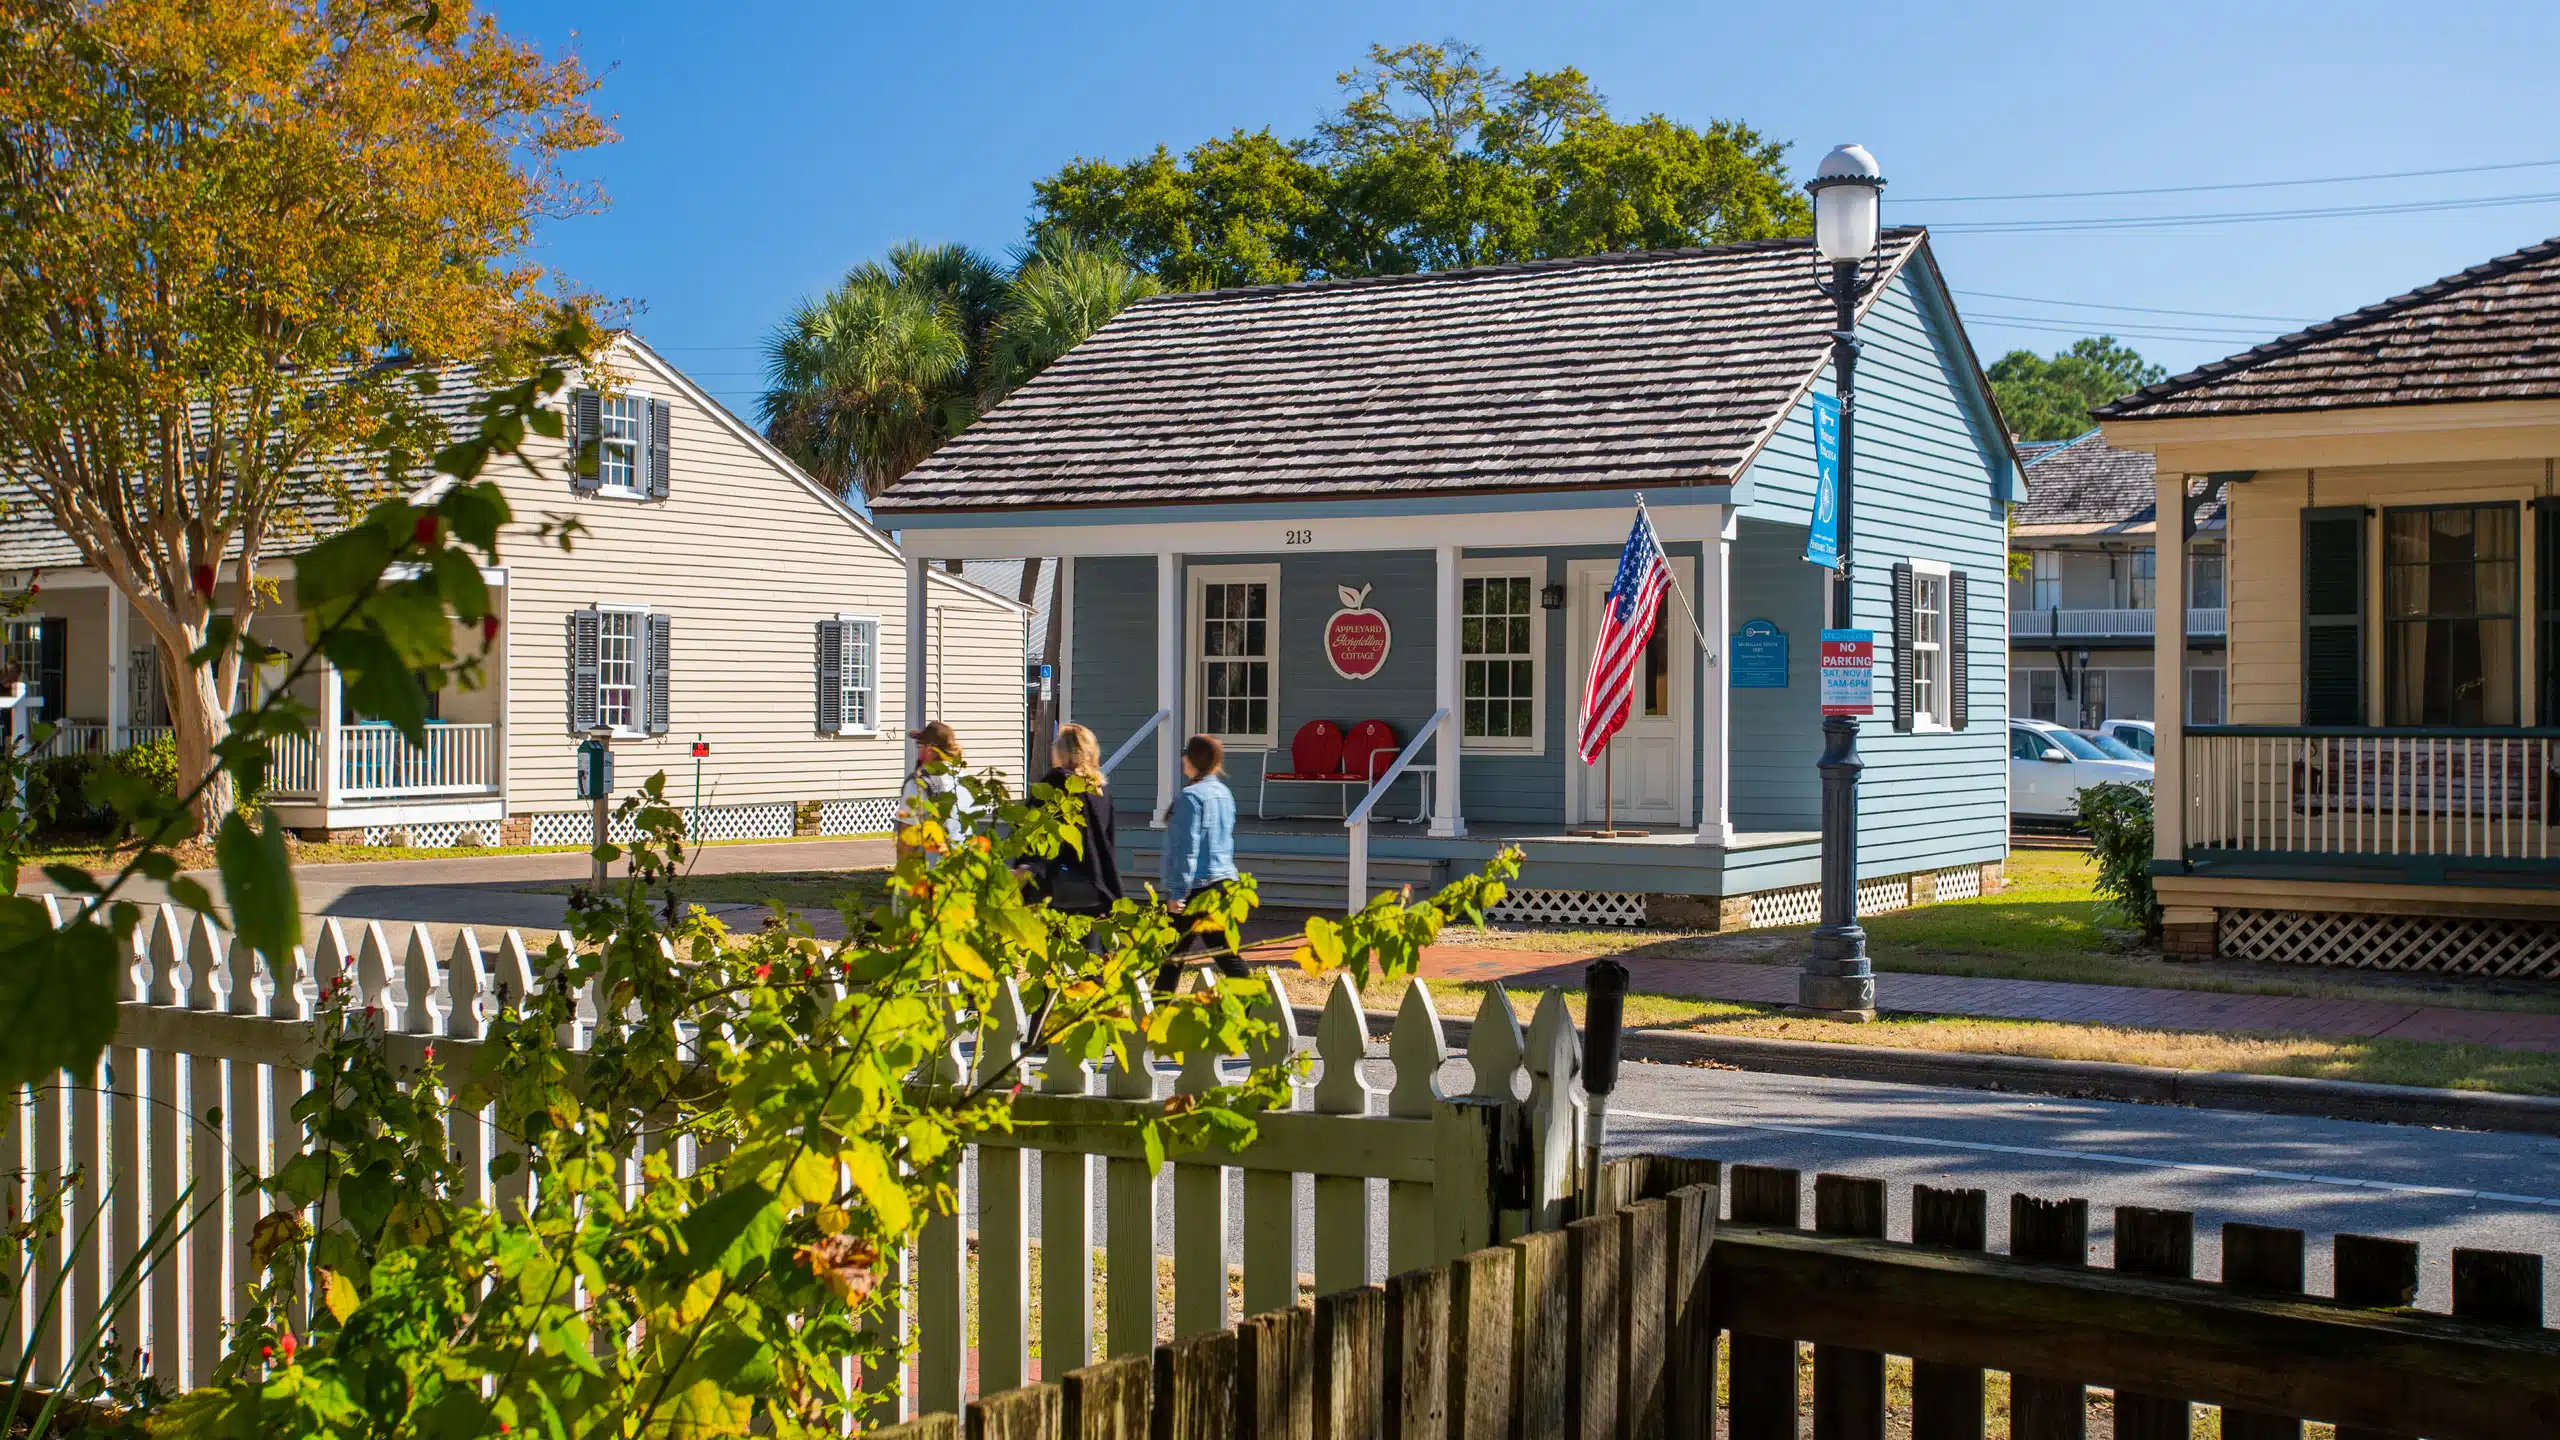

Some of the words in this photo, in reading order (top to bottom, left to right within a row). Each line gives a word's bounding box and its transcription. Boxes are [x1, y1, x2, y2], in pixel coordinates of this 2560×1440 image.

[1286, 529, 1312, 545] 213
[1335, 625, 1382, 633] APPLEYARD
[1332, 633, 1384, 651] Storytelling
[1839, 642, 1856, 653] NO
[1341, 652, 1376, 660] COTTAGE
[1823, 656, 1872, 667] PARKING
[1843, 669, 1861, 677] NOV
[1863, 669, 1873, 677] 16
[1861, 978, 1875, 1000] 29
